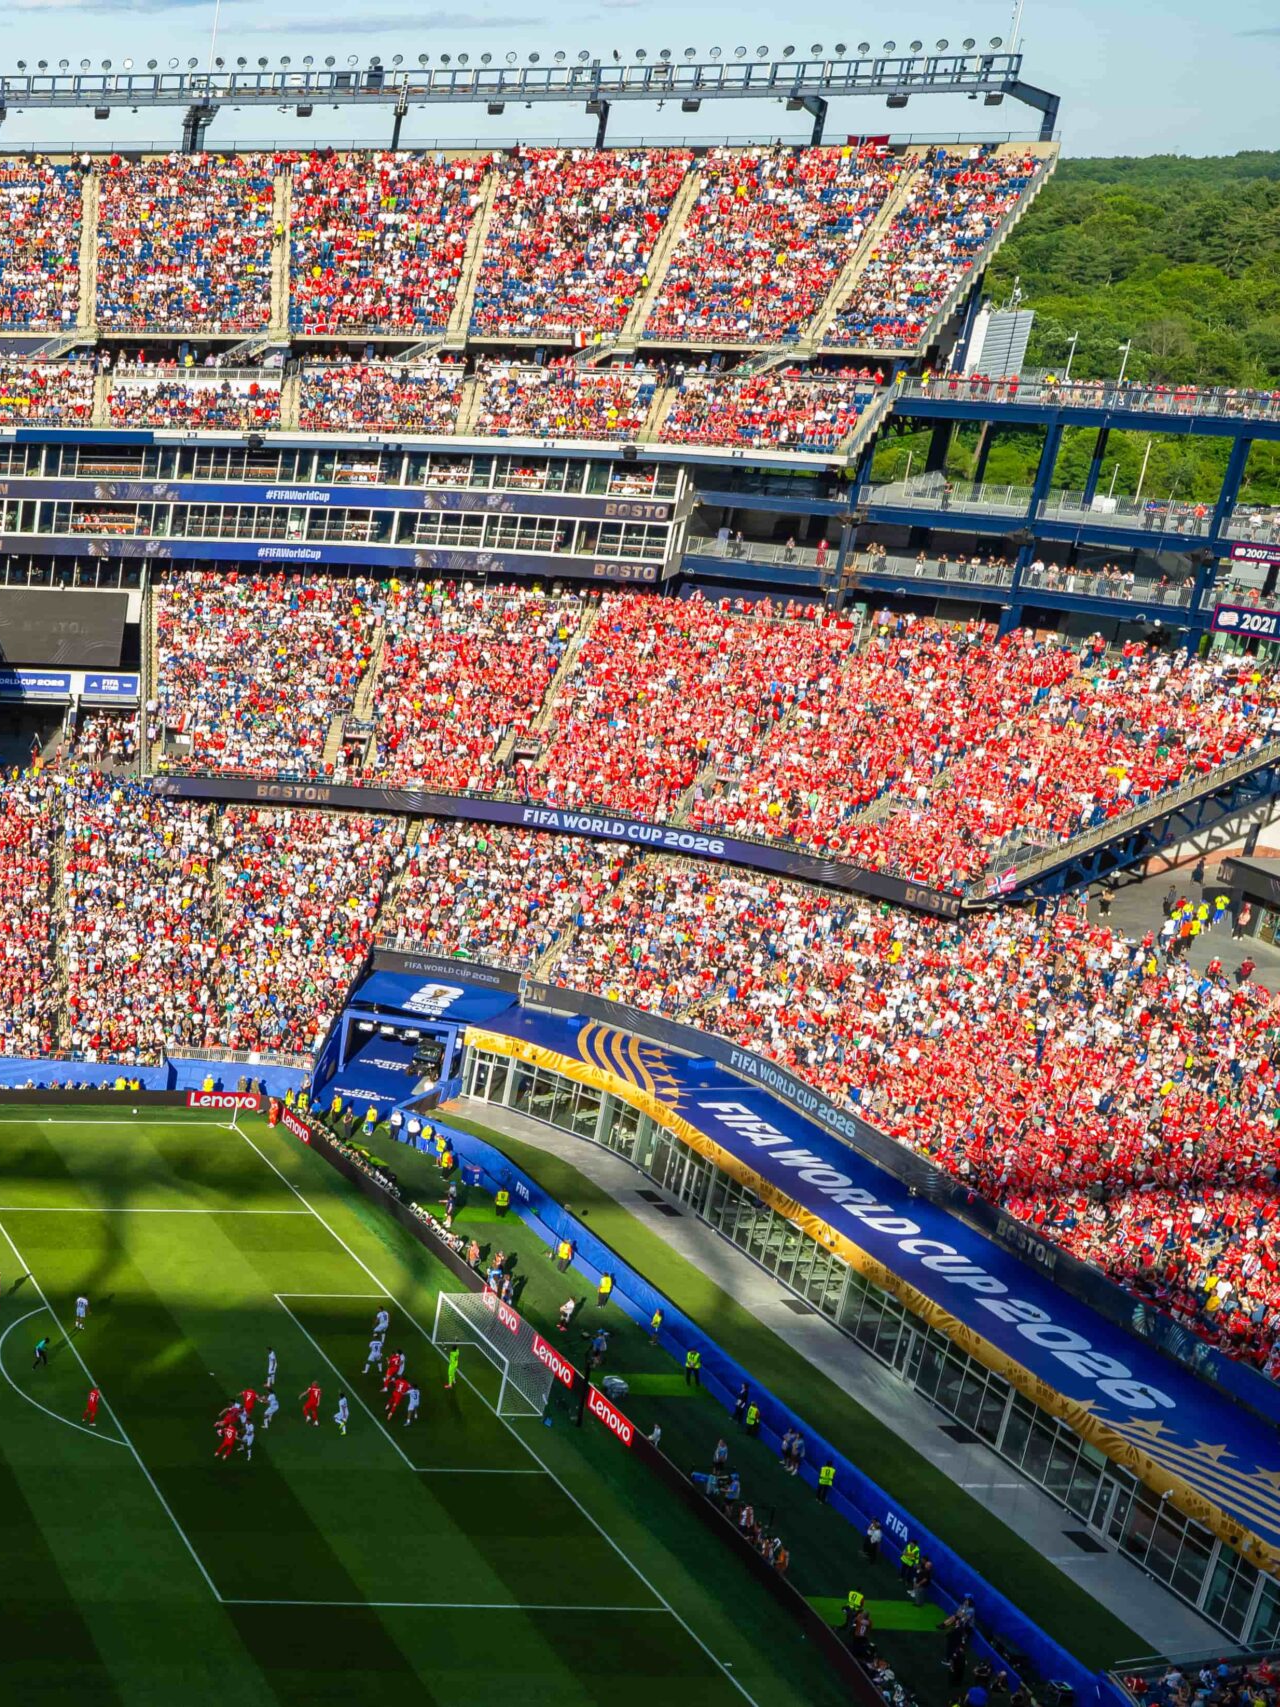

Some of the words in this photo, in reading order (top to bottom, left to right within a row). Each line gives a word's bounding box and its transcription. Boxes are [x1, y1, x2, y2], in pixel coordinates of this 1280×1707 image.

[265, 490, 330, 503] #FIFAWorldCup
[606, 503, 668, 519] BOSTO
[257, 547, 321, 560] #FIFAWorldCup
[1245, 548, 1268, 559] 2007
[594, 563, 656, 580] BOSTO
[1240, 613, 1277, 634] 2021
[102, 679, 119, 687] FIFA
[257, 784, 331, 801] BOSTON
[522, 809, 559, 825] FIFA
[563, 814, 625, 835] WORLD
[627, 823, 663, 841] CUP
[663, 832, 725, 853] 2026
[404, 961, 422, 970] FIFA
[424, 964, 453, 975] WORLD
[455, 968, 471, 978] CUP
[471, 972, 500, 984] 2026
[190, 1093, 257, 1109] Lenovo
[730, 1050, 758, 1076] FIFA
[759, 1063, 796, 1097] WORLD
[796, 1087, 818, 1111] CUP
[817, 1103, 856, 1138] 2026
[282, 1107, 309, 1142] Lenovo
[515, 1181, 530, 1202] FIFA
[996, 1218, 1058, 1269] BOSTON
[698, 1101, 793, 1148] FIFA
[770, 1148, 922, 1236] WORLD
[897, 1238, 1009, 1295] CUP
[974, 1298, 1178, 1411] 2026
[533, 1334, 572, 1385] Lenovo
[589, 1391, 631, 1444] Lenovo
[885, 1511, 909, 1542] FIFA
